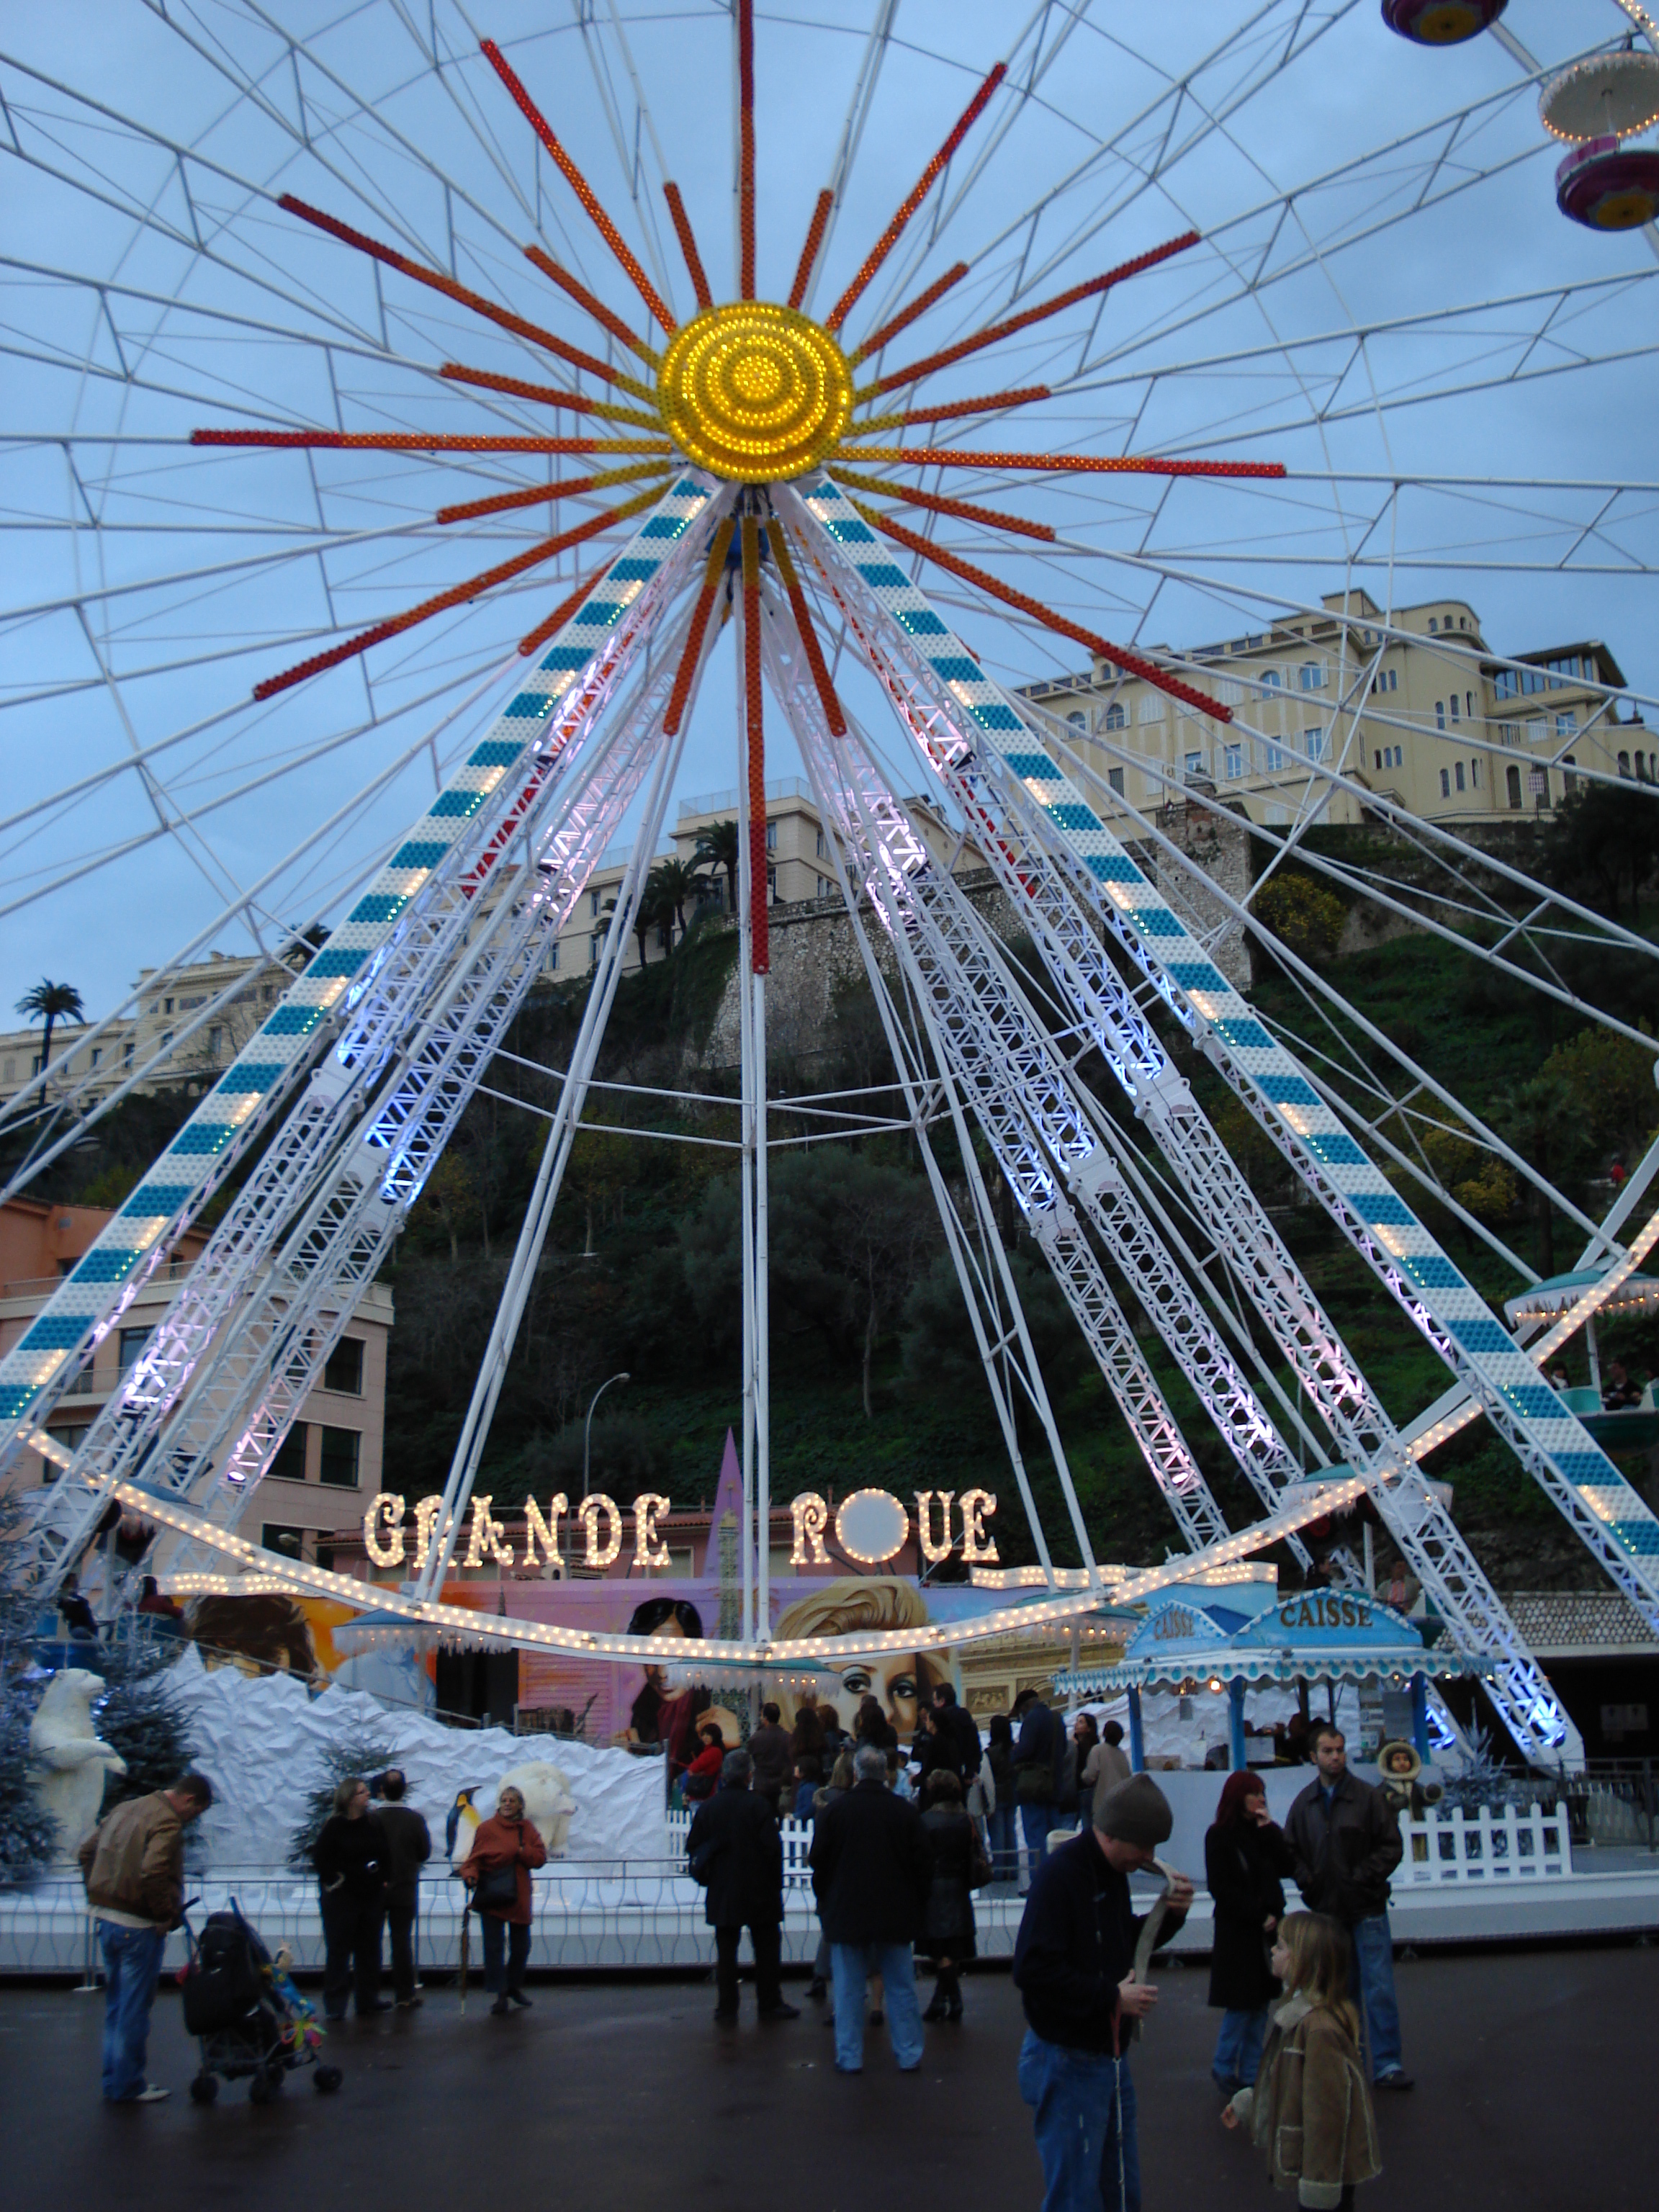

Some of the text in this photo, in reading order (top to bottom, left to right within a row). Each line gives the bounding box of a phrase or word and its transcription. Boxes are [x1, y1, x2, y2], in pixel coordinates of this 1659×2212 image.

[364, 1488, 1000, 1568] GRANDE ROUE
[1154, 1609, 1195, 1640] CAISSE
[1280, 1599, 1372, 1627] CAISSE
